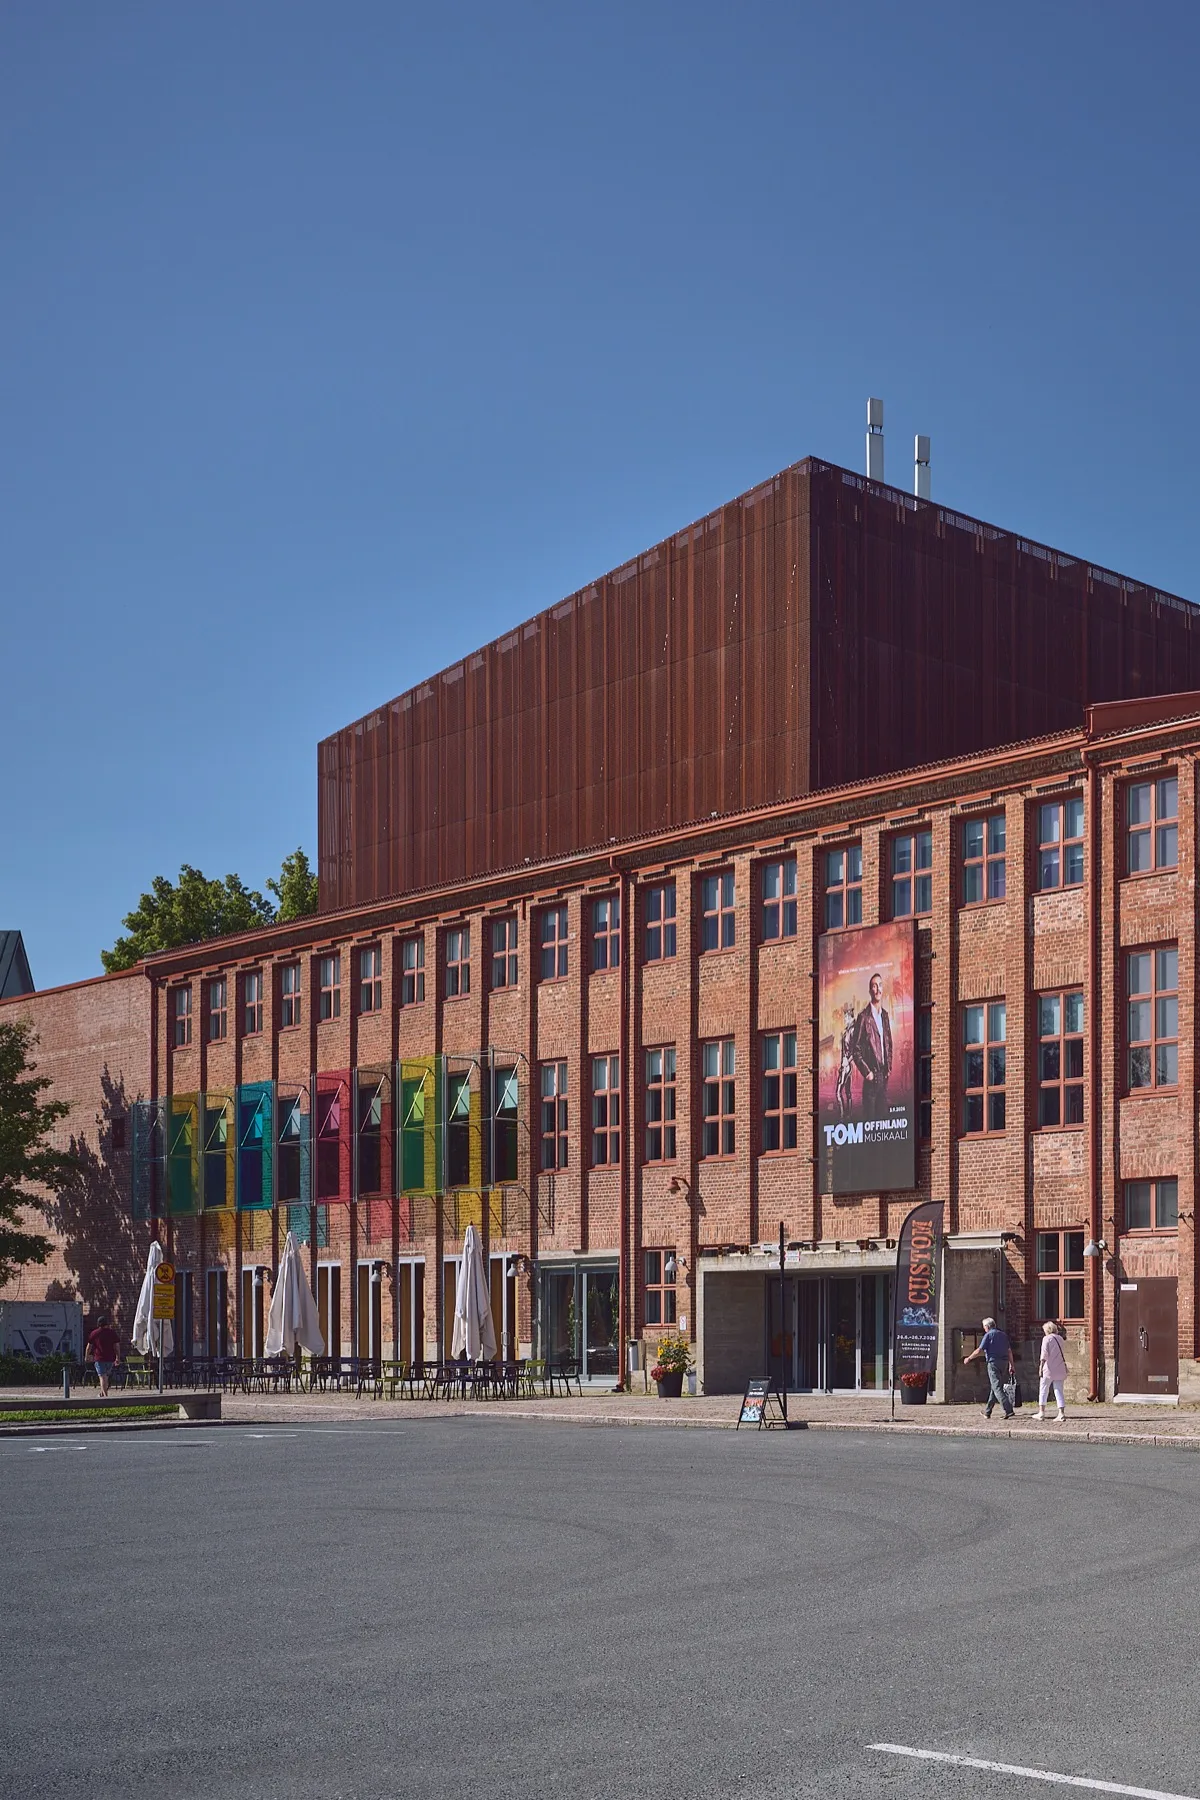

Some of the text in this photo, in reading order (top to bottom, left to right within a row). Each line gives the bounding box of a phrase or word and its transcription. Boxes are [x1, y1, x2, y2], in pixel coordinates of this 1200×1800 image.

[823, 1118, 908, 1146] TOM OF FINLAND
[864, 1130, 908, 1143] MUSIKAALI
[908, 1219, 934, 1304] CUSTOM
